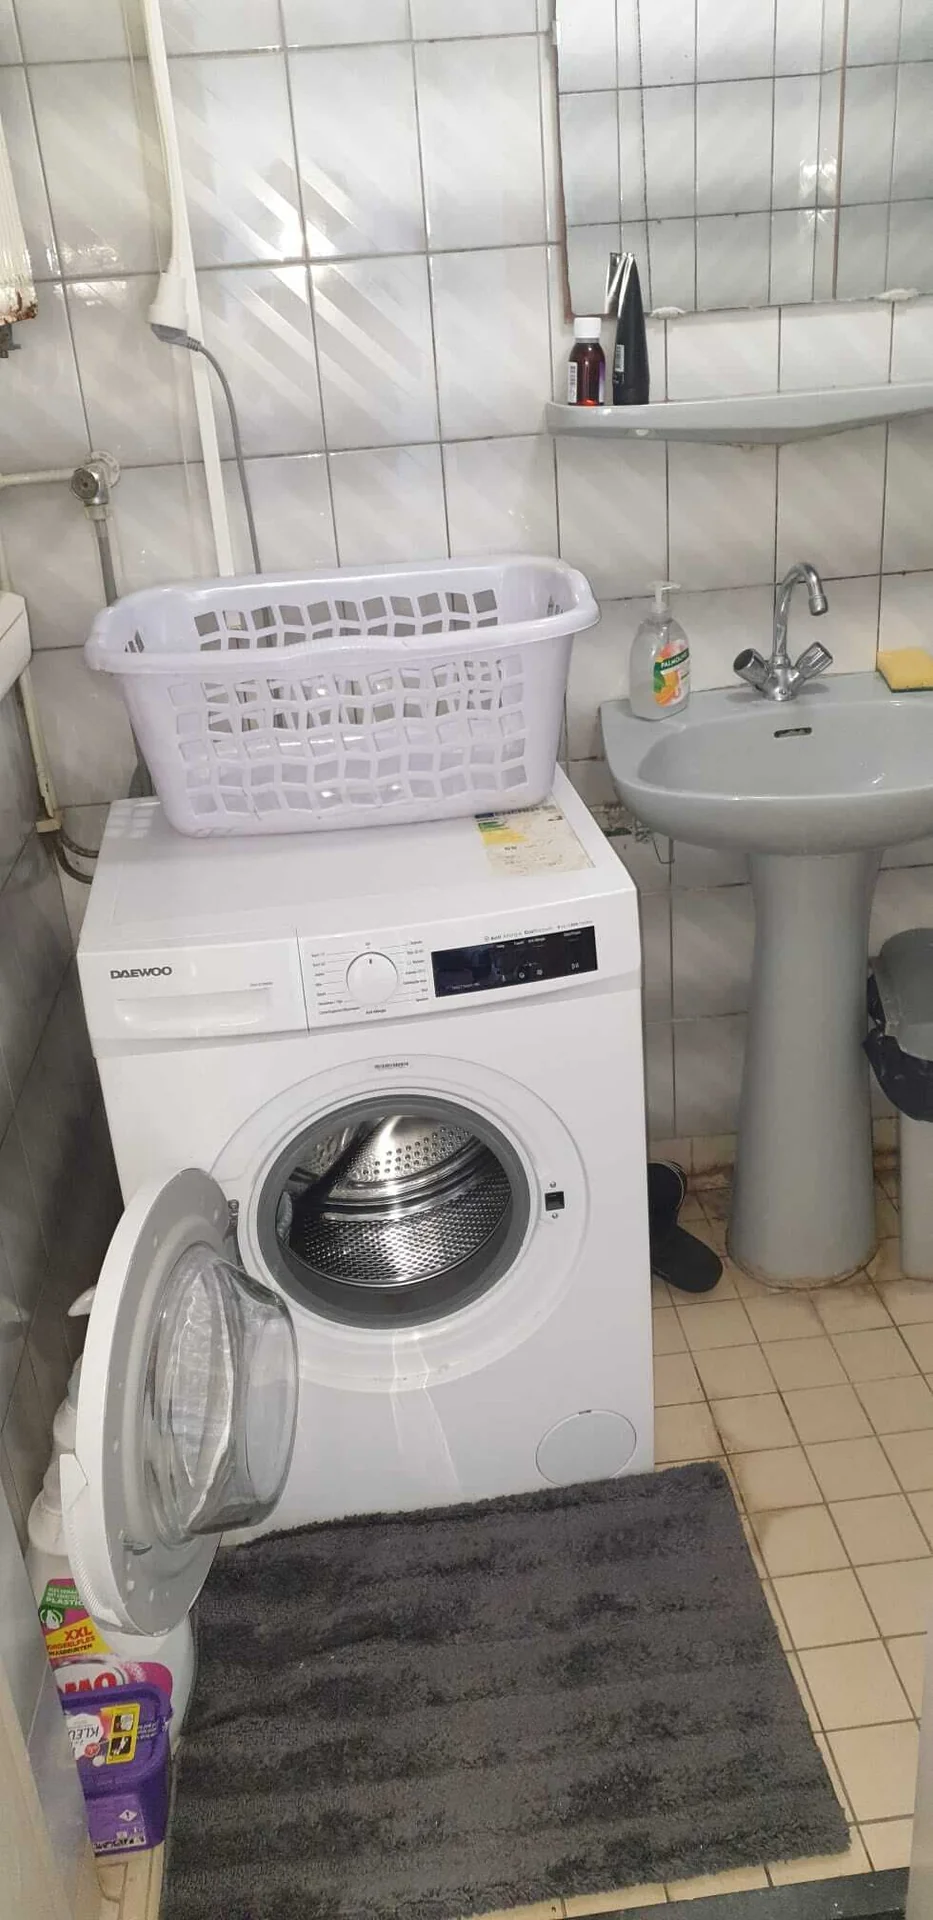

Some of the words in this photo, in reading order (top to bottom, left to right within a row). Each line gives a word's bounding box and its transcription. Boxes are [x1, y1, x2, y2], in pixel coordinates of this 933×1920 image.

[110, 966, 173, 980] DAEWOO
[64, 1626, 93, 1641] XXL
[60, 1671, 117, 1693] MO
